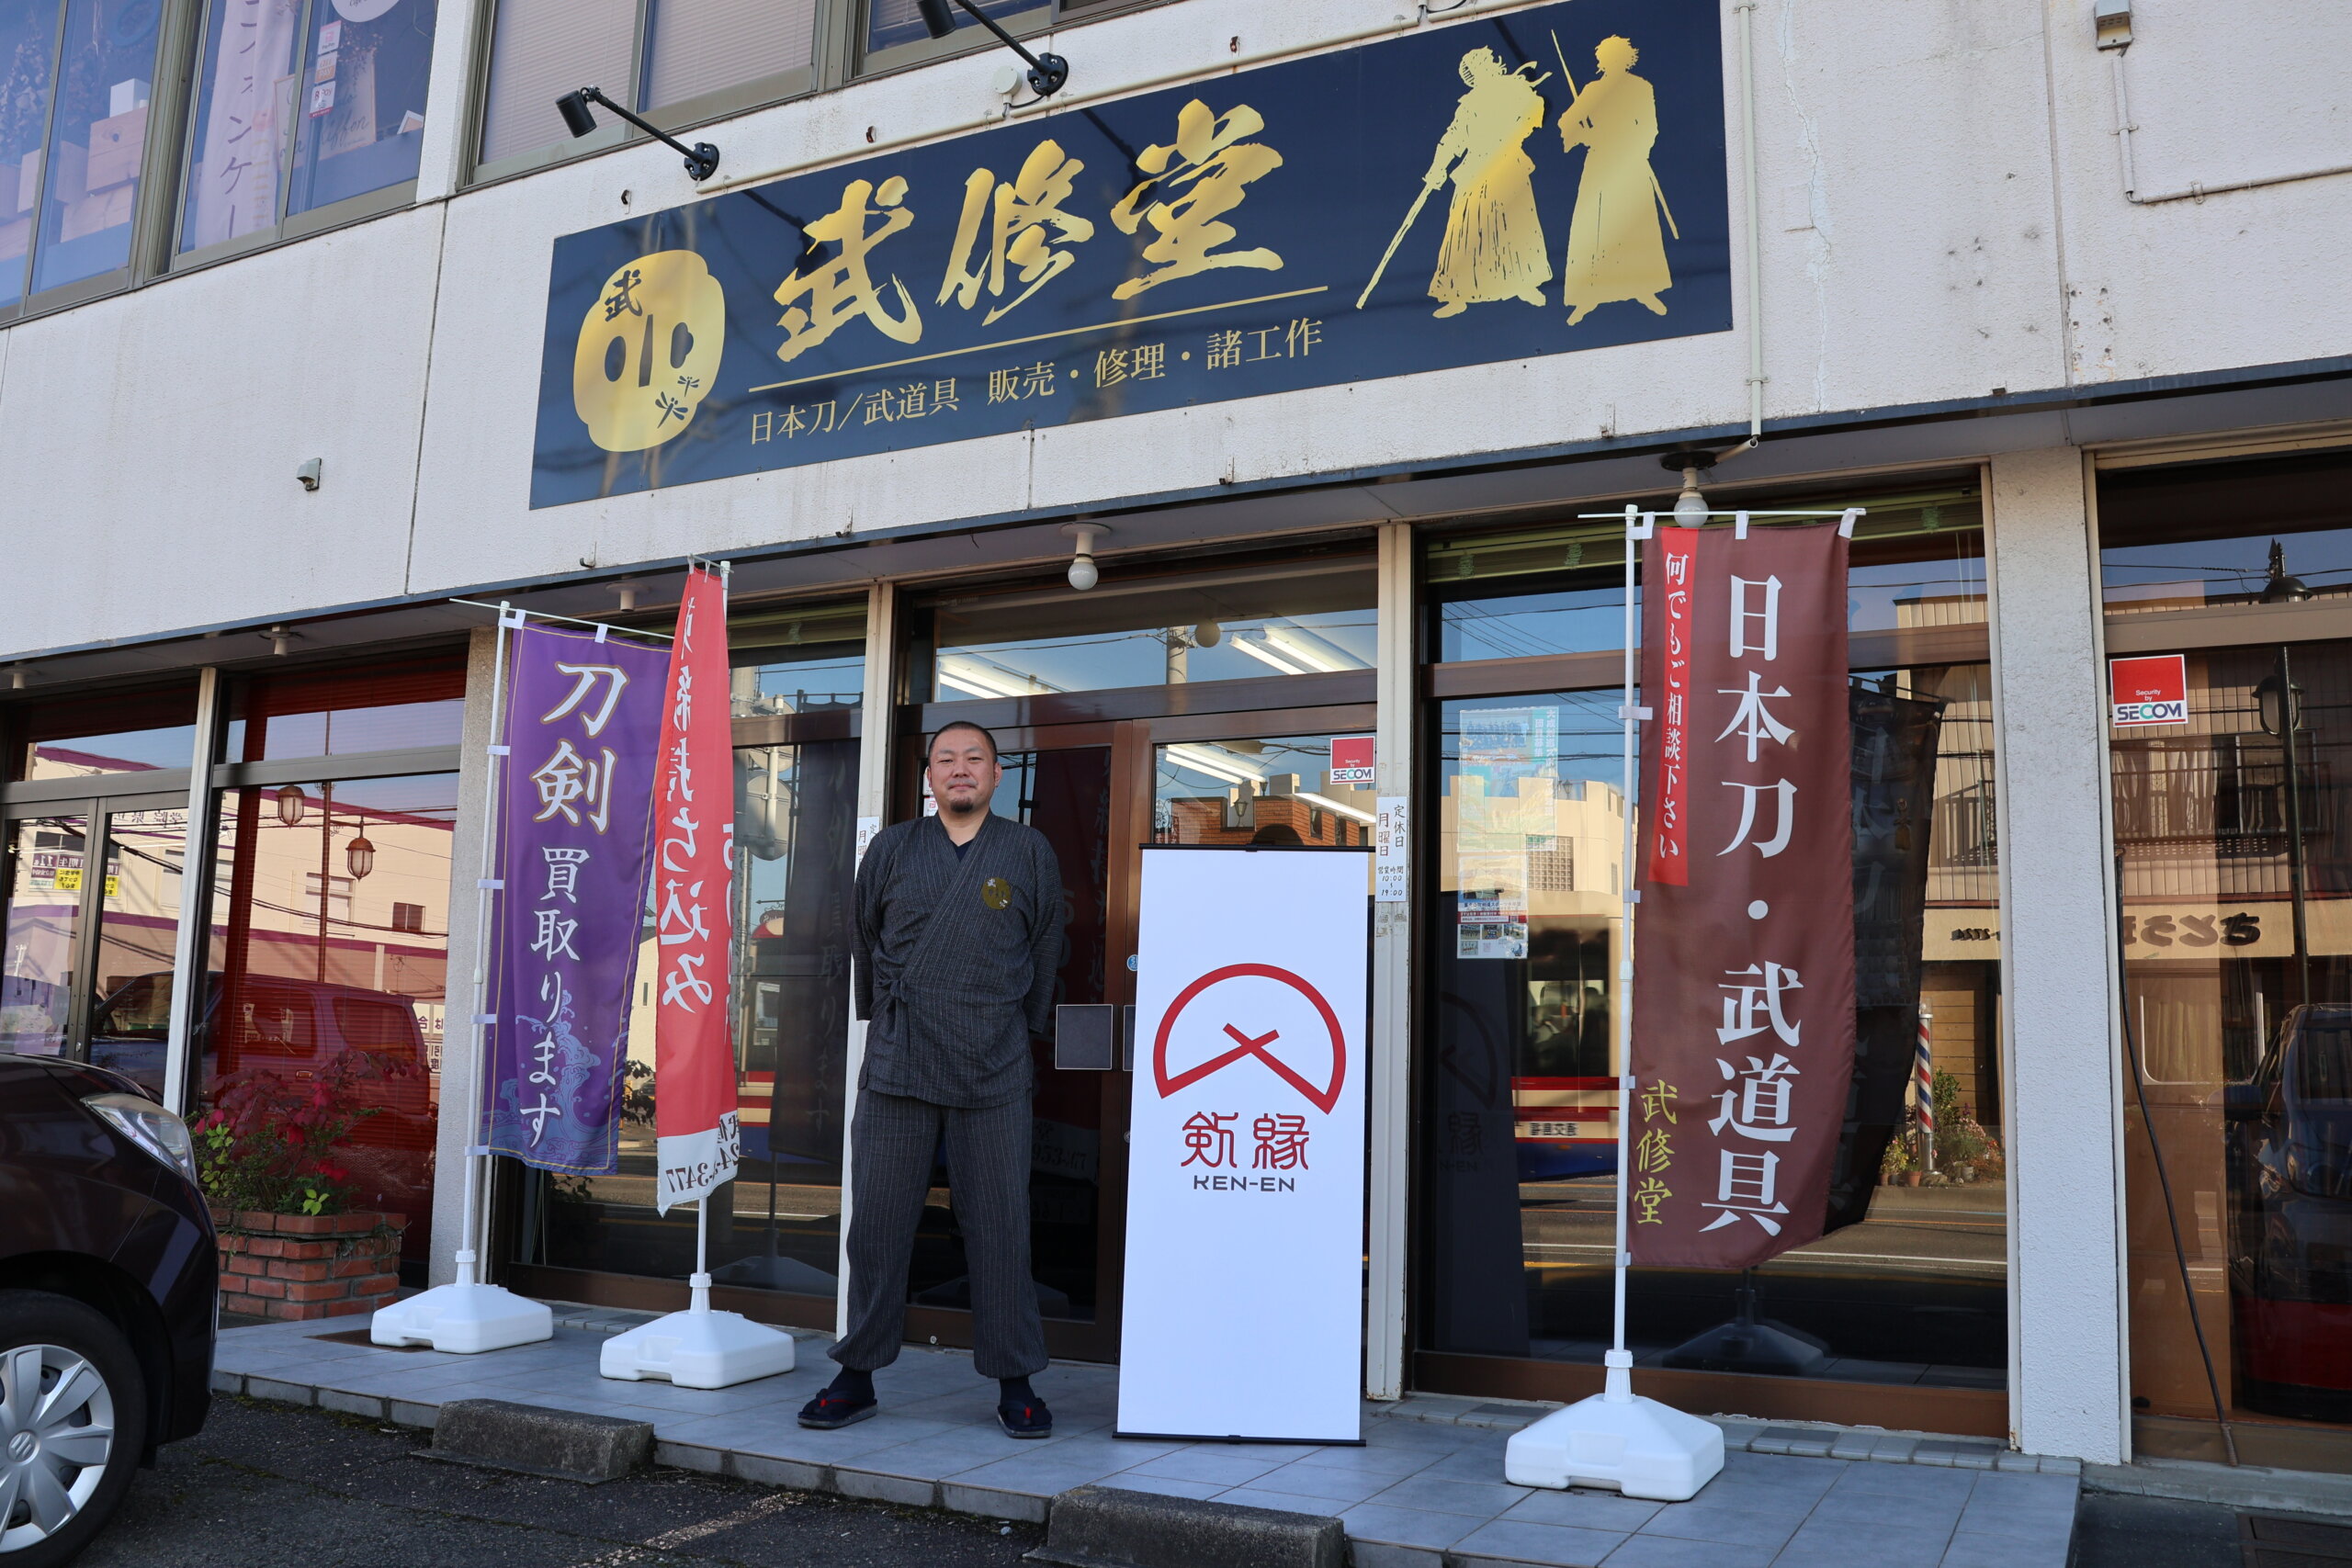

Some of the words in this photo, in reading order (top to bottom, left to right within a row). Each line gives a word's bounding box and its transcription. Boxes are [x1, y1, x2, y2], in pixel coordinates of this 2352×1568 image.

[774, 99, 1284, 364] 武修堂
[605, 268, 643, 321] 武
[1659, 552, 1690, 859] 何でもご相談下さい
[2117, 703, 2182, 720] SECOM
[1333, 768, 1372, 780] SECOM
[1378, 812, 1390, 856] 月曜日
[1394, 804, 1406, 848] 定休日
[1378, 865, 1404, 874] 営業時間
[519, 660, 630, 1148] 刀剣買取ります
[1699, 574, 1804, 1236] 日本刀・武道具
[1634, 1079, 1679, 1224] 武修堂
[1193, 1175, 1295, 1192] KEN-EN
